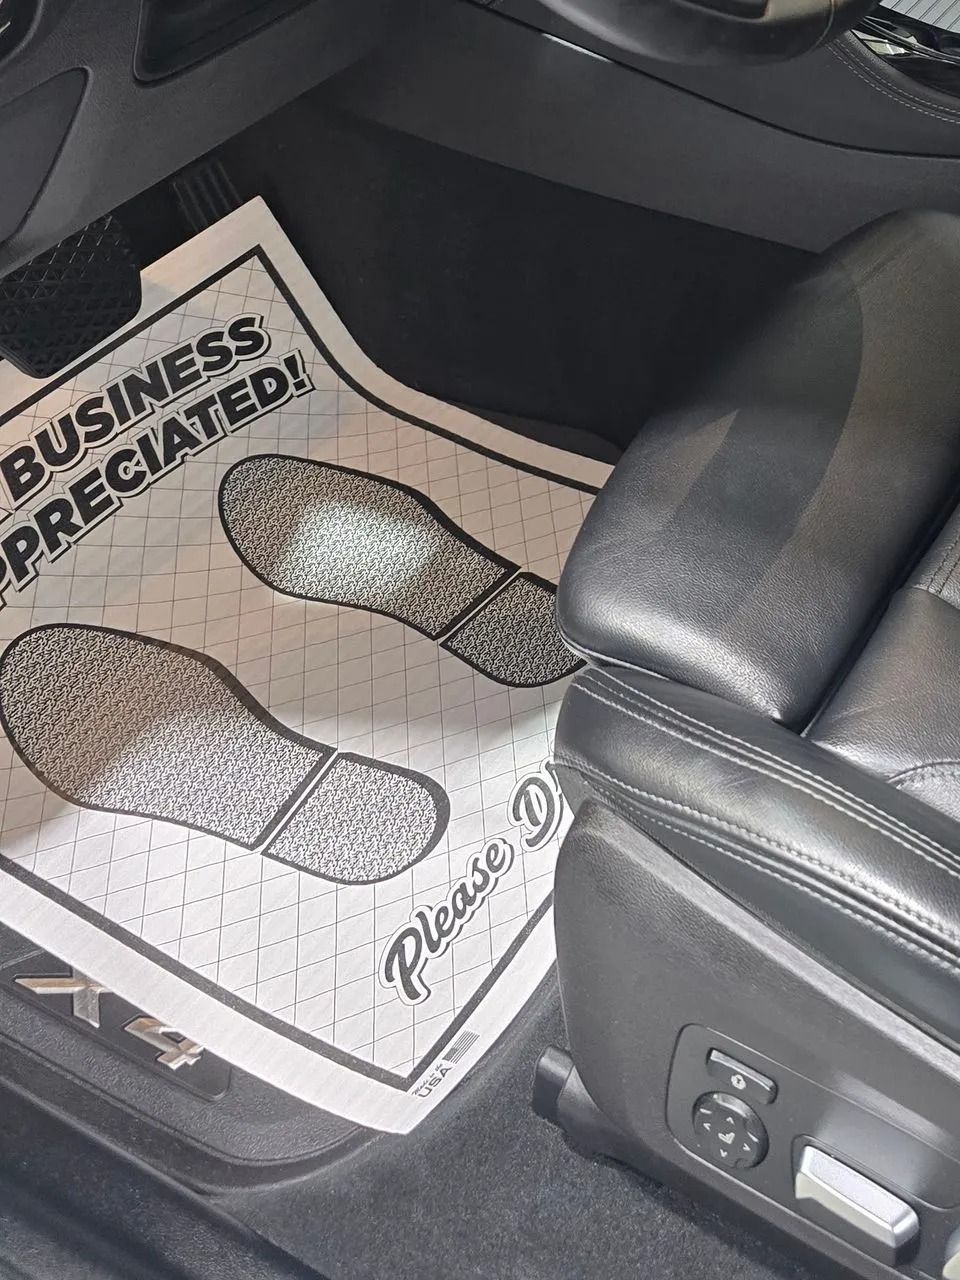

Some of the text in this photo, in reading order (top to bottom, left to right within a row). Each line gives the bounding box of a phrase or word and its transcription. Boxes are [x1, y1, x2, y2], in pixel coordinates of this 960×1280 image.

[0, 350, 312, 592] PRECIATED!
[1, 314, 268, 506] BUSINESS
[382, 840, 512, 1004] Please
[418, 1066, 453, 1098] USA
